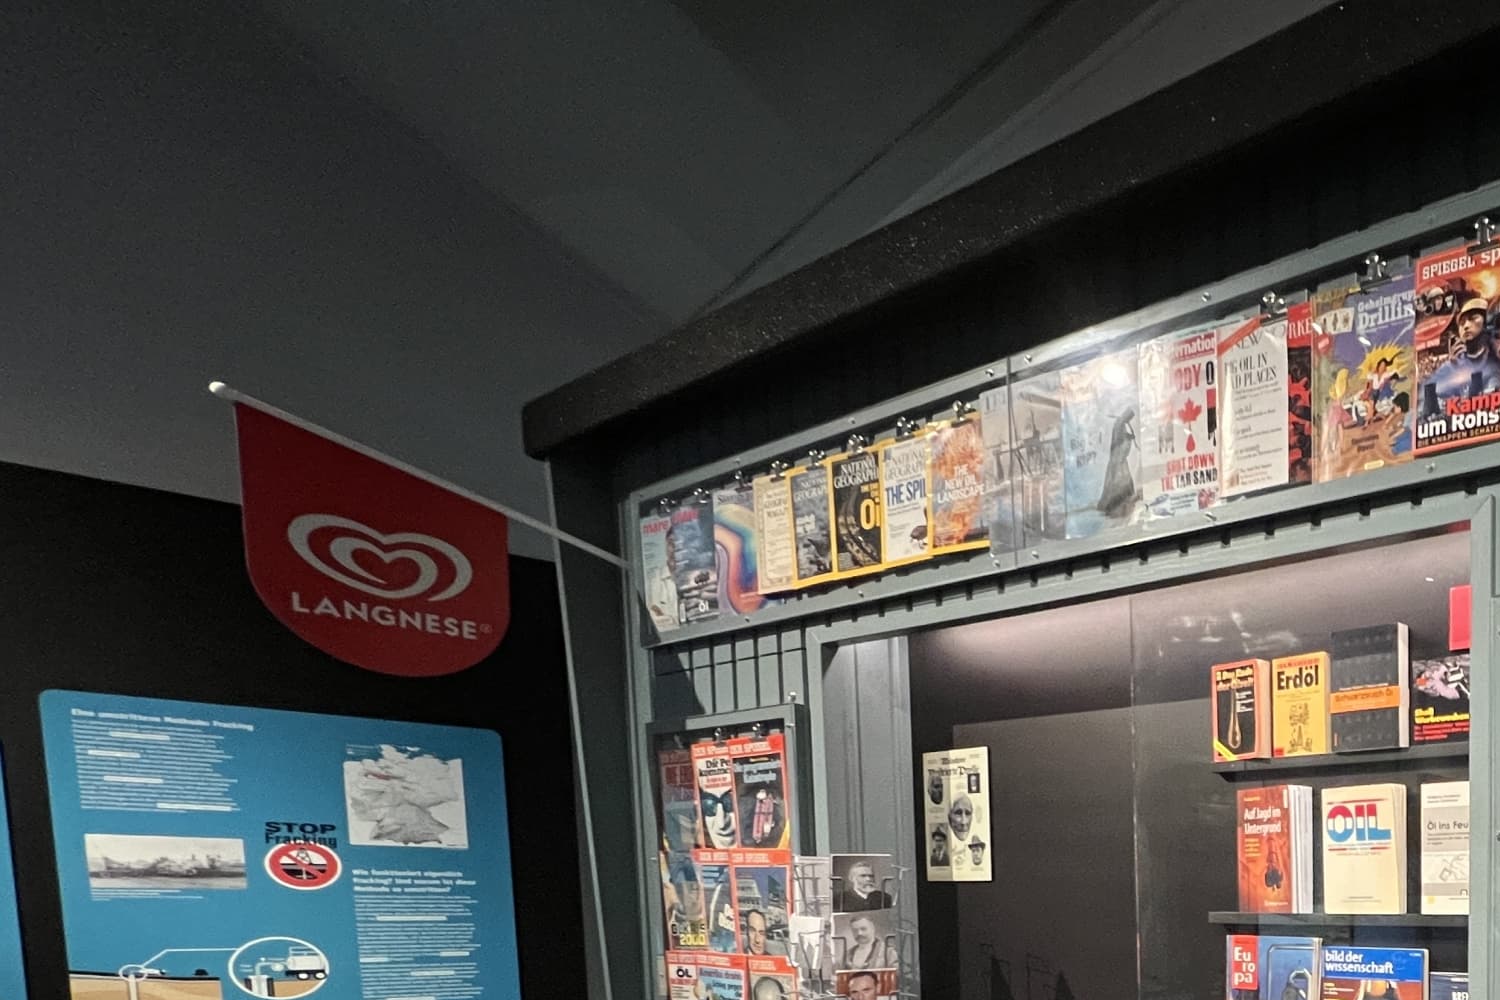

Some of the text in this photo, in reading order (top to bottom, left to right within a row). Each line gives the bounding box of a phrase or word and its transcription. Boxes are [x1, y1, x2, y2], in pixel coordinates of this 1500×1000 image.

[1422, 256, 1476, 280] SPIEGEL
[1244, 365, 1278, 390] PLACES
[1418, 417, 1446, 438] um
[1188, 452, 1214, 469] DOWN
[886, 482, 905, 506] THE
[291, 591, 478, 640] LANGNESE
[1277, 664, 1318, 690] Erdöl
[265, 822, 336, 835] STOP
[1327, 804, 1392, 842] OIL
[264, 832, 338, 848] Fracking
[1234, 946, 1251, 962] Eu
[1325, 950, 1363, 963] bild der
[1325, 962, 1394, 974] wissenschaft
[1234, 972, 1252, 986] pa
